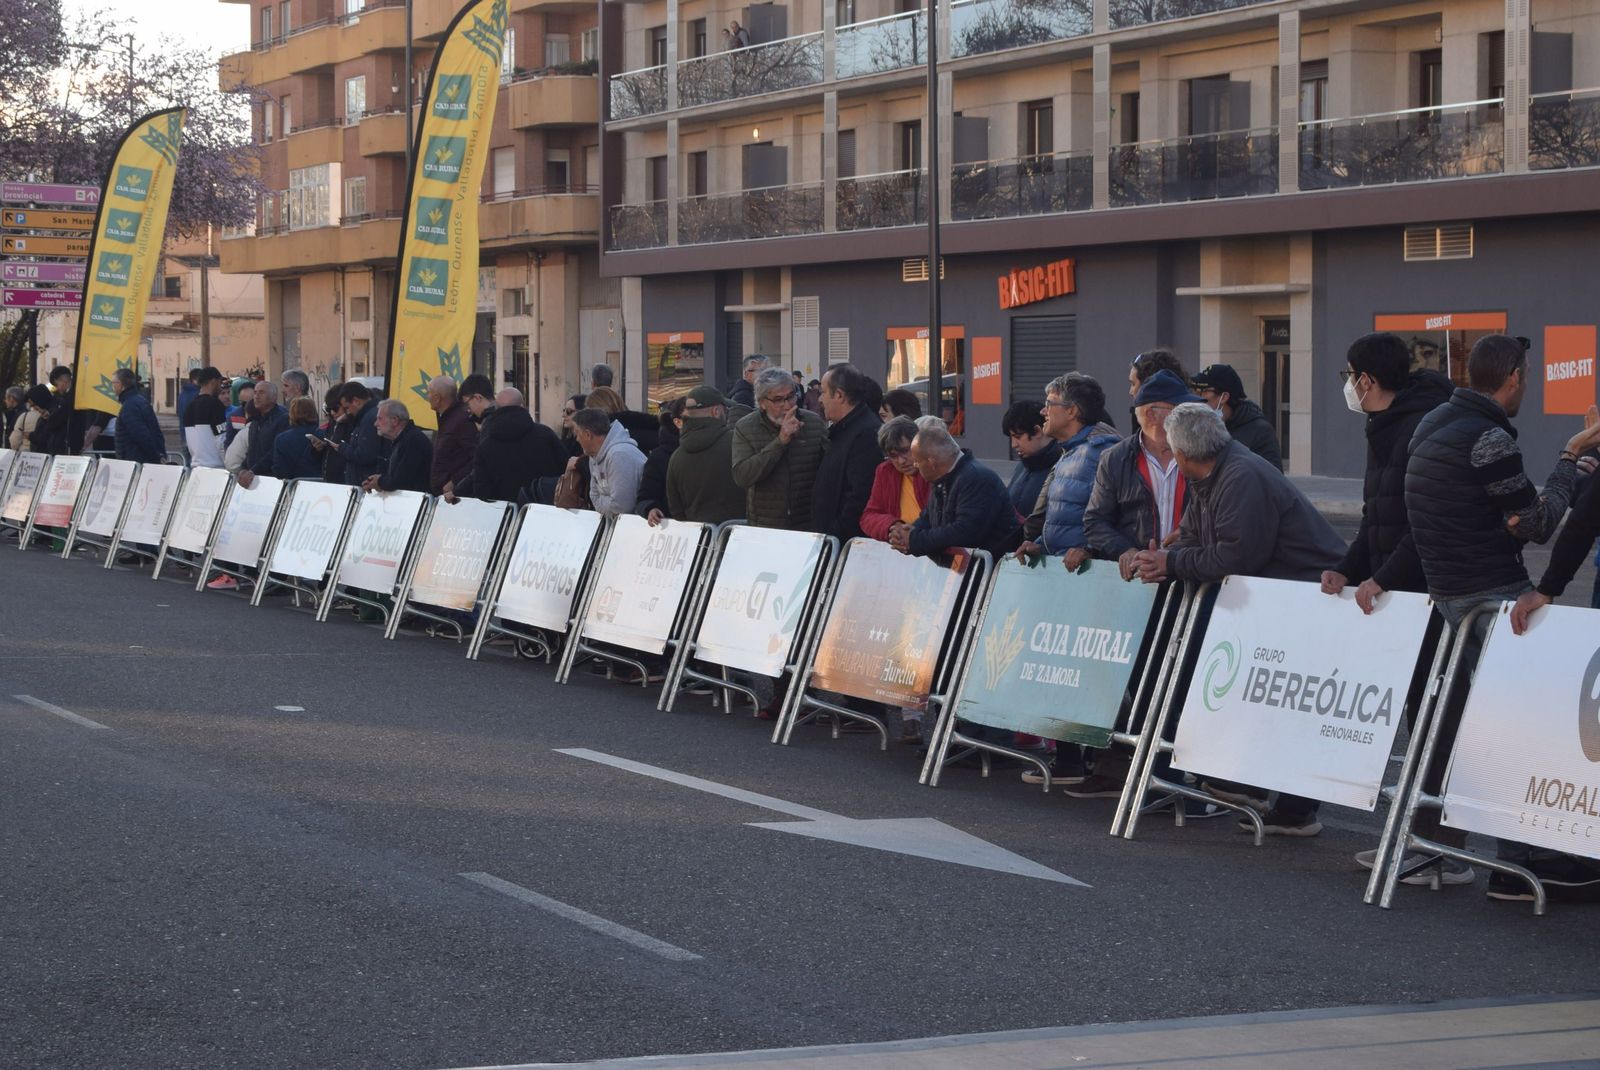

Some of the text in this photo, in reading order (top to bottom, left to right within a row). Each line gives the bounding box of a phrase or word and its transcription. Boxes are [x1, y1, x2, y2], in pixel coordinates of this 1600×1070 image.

[472, 65, 488, 120] Zamora
[4, 192, 43, 200] provincial
[136, 206, 153, 257] Valladolid
[448, 130, 479, 314] León Ourense Valladolid
[409, 285, 424, 294] CAJA
[521, 557, 577, 596] cobreros
[1030, 621, 1133, 664] CAJA RURAL
[1253, 647, 1285, 664] GRUPO
[1019, 662, 1080, 688] DE ZAMORA
[1242, 667, 1393, 727] IBEREÓLICA
[1320, 724, 1374, 745] RENOVABLES
[1525, 776, 1600, 817] MORAL
[1519, 812, 1593, 838] SELECC
